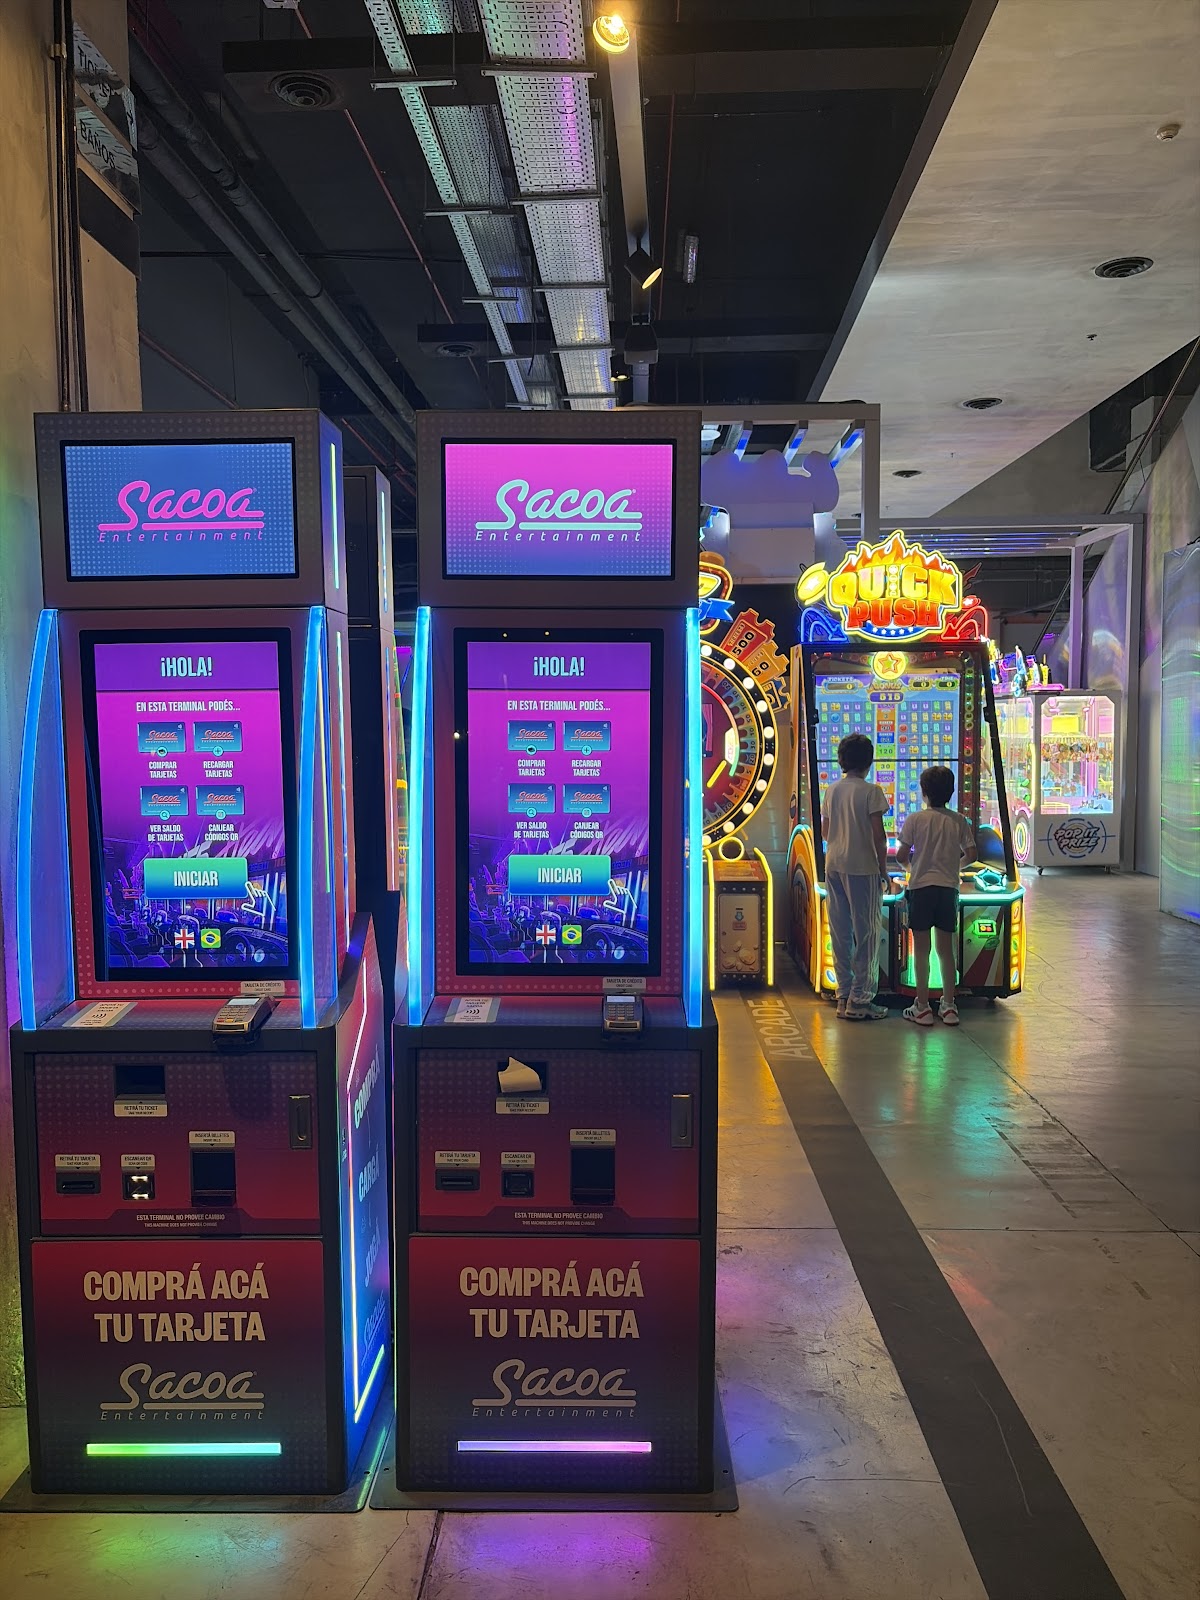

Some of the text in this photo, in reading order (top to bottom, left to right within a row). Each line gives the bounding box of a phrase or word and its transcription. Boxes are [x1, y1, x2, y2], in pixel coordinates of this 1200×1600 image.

[80, 118, 116, 169] BAÑOS
[98, 480, 264, 530] Sacoa
[475, 479, 642, 530] Sacoa
[99, 531, 264, 542] Entertainment
[475, 531, 641, 541] Entertainment
[831, 564, 957, 608] QUICK
[847, 597, 940, 628] PUSH
[732, 631, 754, 655] 500
[160, 656, 213, 677] ¡HOLA!
[533, 656, 585, 676] ¡HOLA!
[752, 661, 769, 676] 60
[136, 702, 146, 711] EN
[148, 701, 167, 711] ESTA
[168, 701, 207, 711] TERMINAL
[507, 698, 610, 710] EN ESTA TERMINAL PODÉS...
[148, 761, 177, 769] COMPRAR
[149, 770, 177, 778] TARJETAS
[208, 824, 234, 832] CANJEAR
[522, 830, 549, 838] TARJETAS
[574, 822, 600, 830] CANJEAR
[1055, 828, 1098, 839] POP IT
[157, 833, 184, 841] TARJETAS
[1060, 838, 1097, 849] PRIZE
[173, 870, 219, 888] INICIAR
[537, 866, 582, 884] INICIAR
[747, 1000, 813, 1058] ARCADE
[83, 1262, 269, 1301] COMPRÁ ACÁ
[459, 1260, 644, 1298] COMPRÁ ACÁ
[94, 1311, 266, 1343] TU TARJETA
[469, 1308, 640, 1339] TU TARJETA
[100, 1362, 265, 1410] Sacoa
[472, 1358, 637, 1407] Sacoa
[100, 1410, 263, 1421] Entertainment
[472, 1407, 635, 1418] Entertainment
